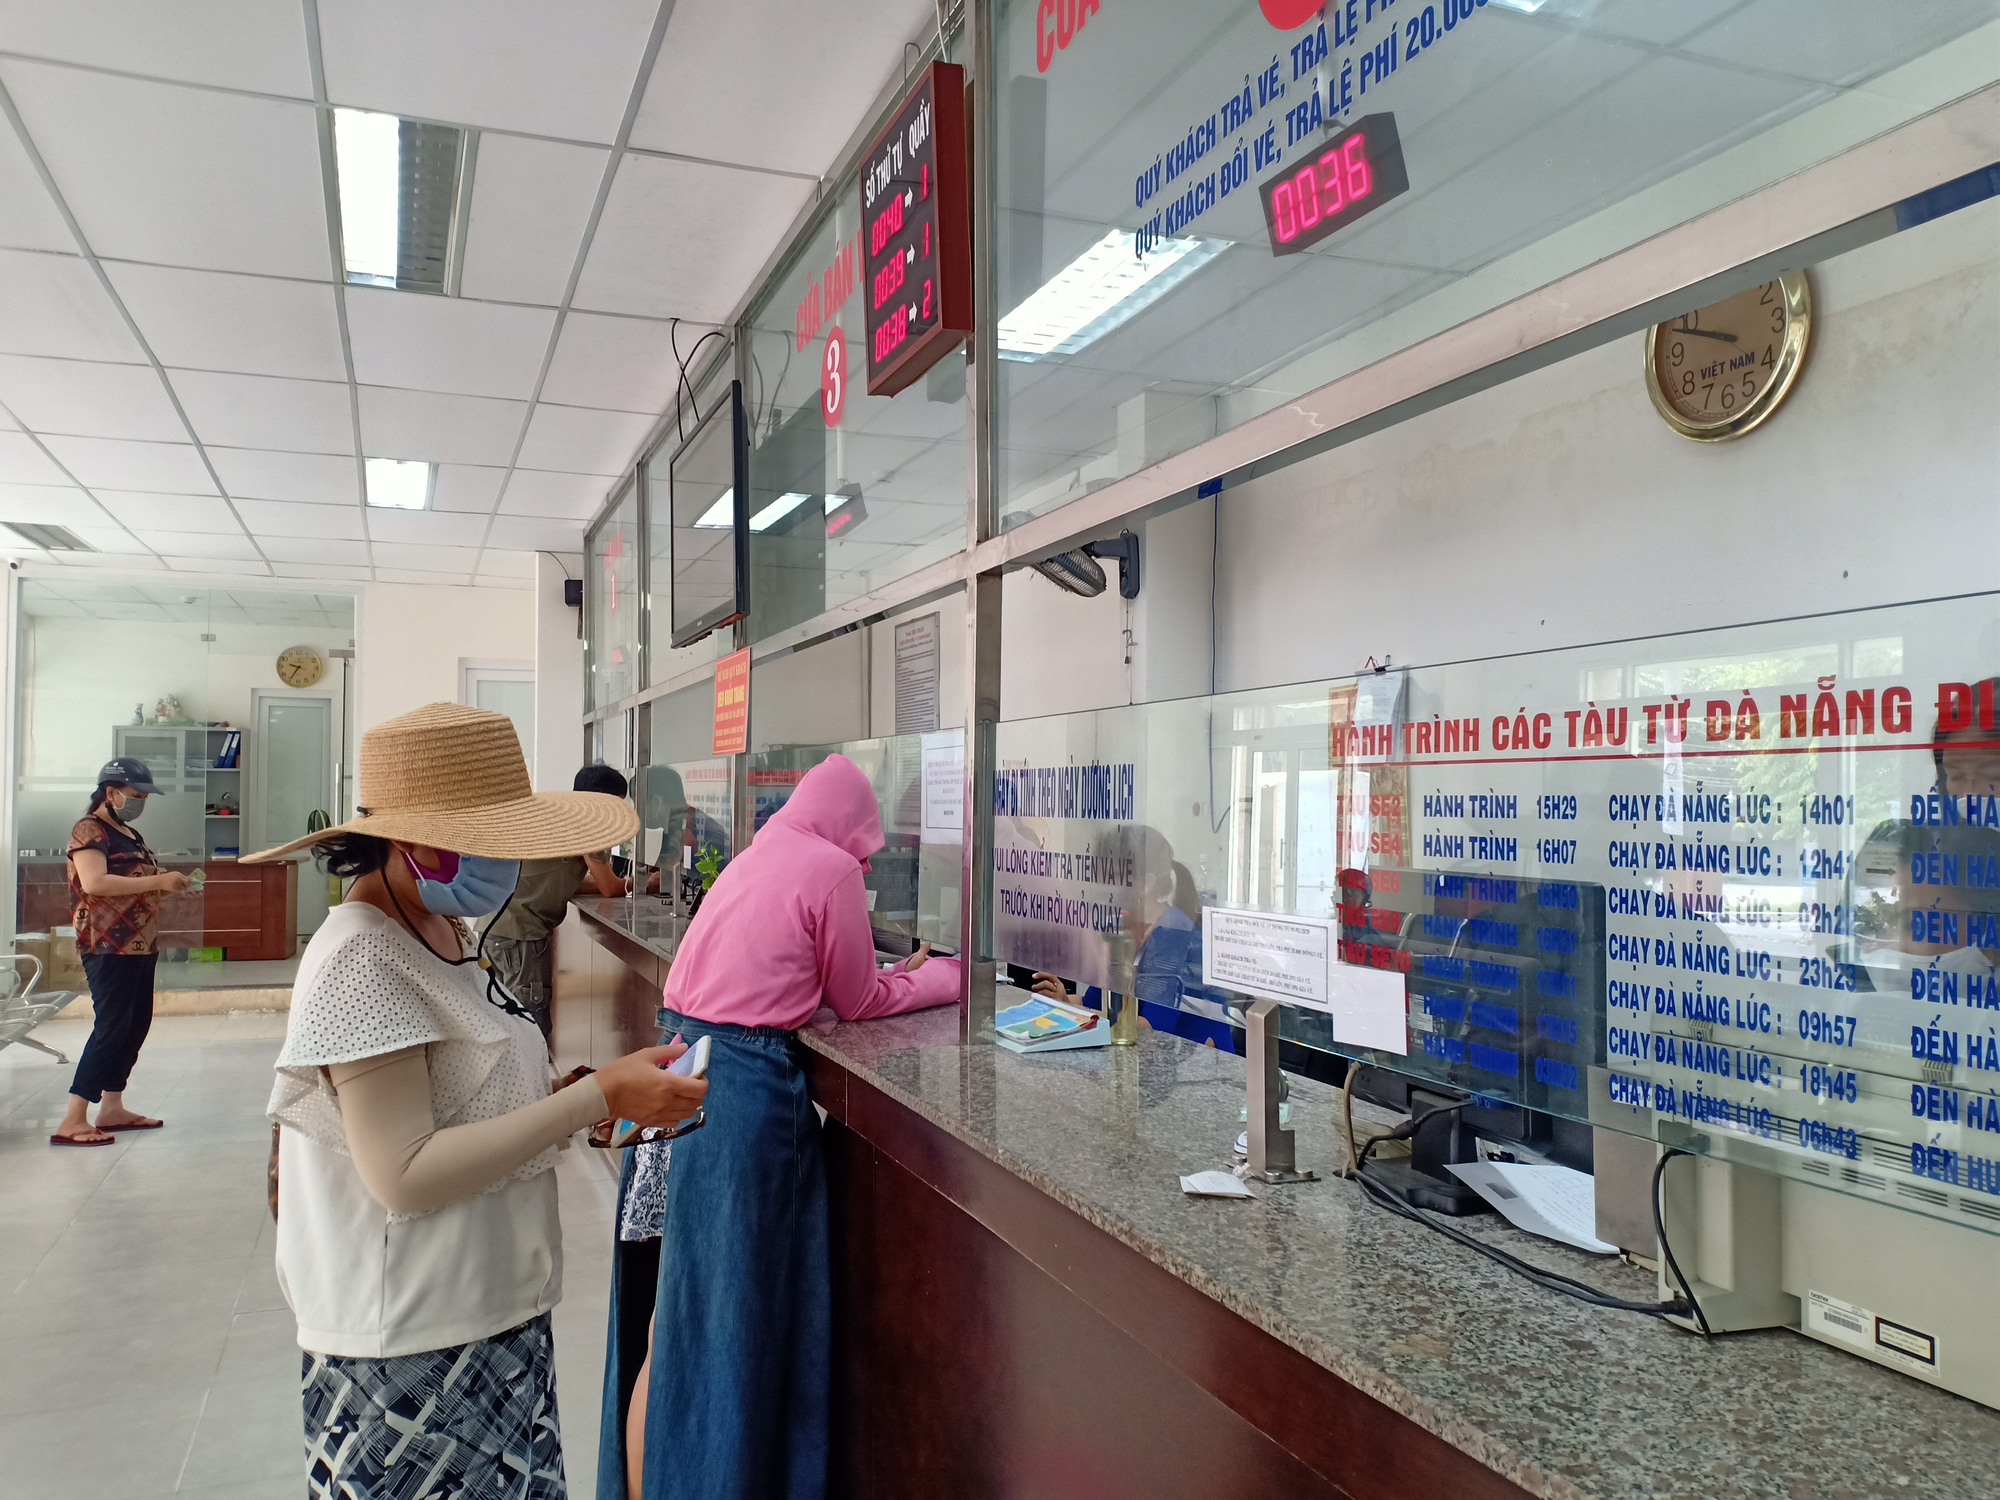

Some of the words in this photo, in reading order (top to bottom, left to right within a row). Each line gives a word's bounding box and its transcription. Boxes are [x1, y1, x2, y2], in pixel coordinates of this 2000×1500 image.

[1135, 208, 1162, 260] QUÝ
[1165, 173, 1216, 239] KHÁCH
[1220, 137, 1248, 199] ĐỔI
[1253, 119, 1282, 173] VÉ,
[1285, 77, 1323, 148] TRẢ
[1328, 57, 1353, 117] LỆ
[1360, 21, 1398, 96] PHÍ
[1136, 154, 1162, 209] QUÝ
[1165, 114, 1216, 184] KHÁCH
[1220, 74, 1253, 139] TRẢ
[1257, 54, 1286, 109] VÉ,
[1290, 8, 1329, 82] TRẢ
[865, 160, 876, 209] SỐ
[892, 130, 904, 177] TỰ
[908, 98, 931, 159] QUẦY
[1271, 132, 1372, 244] 0036
[871, 192, 904, 259] 0040
[823, 240, 854, 323] BÁN
[873, 247, 906, 311] 0039
[1758, 280, 1774, 306] 2
[874, 302, 908, 364] 0038
[922, 278, 932, 320] 2
[1771, 307, 1785, 334] 3
[826, 339, 842, 414] 3
[1671, 342, 1685, 367] 9
[1682, 370, 1696, 396] 8
[1700, 361, 1726, 381] VIỆT
[1729, 351, 1756, 372] NAM
[1741, 370, 1756, 398] 5
[1760, 344, 1776, 371] 4
[1701, 383, 1715, 410] 7
[1720, 384, 1735, 410] 6
[1332, 716, 1393, 757] HÀNH
[1401, 713, 1480, 755] TRÌNH
[1491, 706, 1552, 751] CÁC
[1563, 701, 1629, 749] TÀU
[1642, 694, 1691, 744] TỪ
[1704, 689, 1761, 742] ĐÀ
[1779, 674, 1913, 738] NẴNG
[1933, 679, 1995, 733] ĐI
[1019, 758, 1036, 818] TÍNH
[1037, 767, 1056, 819] THEO
[1057, 755, 1080, 819] NGÀY
[1081, 759, 1111, 820] DƯƠNG
[1113, 763, 1135, 833] LỊCH
[1370, 795, 1401, 817] SE2
[1423, 789, 1465, 818] HÀNH
[1469, 788, 1518, 819] TRÌNH
[1536, 795, 1578, 821] 15H29
[1608, 794, 1651, 829] CHẠY
[1655, 787, 1677, 823] ĐÀ
[1682, 780, 1730, 824] NẴNG
[1735, 786, 1771, 824] LÚC
[1799, 794, 1857, 825] 14h01
[1911, 780, 1958, 827] ĐẾN
[1966, 784, 2000, 828] HÀ
[1005, 841, 1029, 874] LÒNG
[1030, 837, 1052, 878] KIỂM
[1054, 852, 1073, 880] TRA
[1075, 843, 1098, 884] TIỀN
[1101, 849, 1116, 886] VÀ
[1118, 851, 1133, 888] VÉ
[1370, 831, 1402, 855] SE4
[1423, 828, 1465, 859] HÀNH
[1469, 829, 1518, 862] TRÌNH
[1536, 838, 1578, 865] 16H07
[1608, 840, 1651, 876] CHẠY
[1655, 834, 1677, 870] ĐÀ
[1682, 830, 1730, 873] NẴNG
[1735, 838, 1771, 876] LÚC
[1799, 849, 1857, 880] 12h41
[1911, 838, 1958, 886] ĐẾN
[1966, 844, 2000, 889] HÀ
[1000, 884, 1028, 918] TRƯỚC
[1030, 893, 1046, 921] KHI
[1047, 889, 1063, 924] RỜI
[1065, 889, 1089, 929] KHỎI
[1091, 892, 1122, 935] QUẦY
[1370, 868, 1401, 893] SE6
[1423, 868, 1465, 899] HÀNH
[1469, 871, 1518, 904] TRÌNH
[1655, 883, 1677, 919] ĐÀ
[1682, 879, 1730, 924] NẴNG
[1911, 897, 1958, 945] ĐẾN
[1966, 905, 2000, 950] HÀ
[1608, 933, 1651, 971] CHẠY
[1655, 932, 1677, 967] ĐÀ
[1682, 929, 1730, 976] NẴNG
[1799, 956, 1857, 992] 23h23
[1911, 956, 1958, 1005] ĐẾN
[1966, 966, 2000, 1011] HÀ
[1336, 934, 1366, 965] TÀU
[1370, 944, 1412, 973] SE10
[1608, 980, 1651, 1019] CHẠY
[1655, 980, 1677, 1017] ĐÀ
[1682, 979, 1730, 1027] NẴNG
[1735, 993, 1771, 1034] LÚC
[1799, 1009, 1857, 1048] 09h57
[1911, 1015, 1958, 1065] ĐẾN
[1966, 1027, 2000, 1072] HÀ
[1608, 1026, 1651, 1066] CHẠY
[1655, 1029, 1677, 1066] ĐÀ
[1735, 1045, 1771, 1086] LÚC
[1799, 1063, 1857, 1104] 18h45
[1966, 1088, 2000, 1134] HÀ
[1608, 1073, 1651, 1114] CHẠY
[1655, 1078, 1677, 1116] ĐÀ
[1682, 1079, 1730, 1123] NẴNG
[1735, 1097, 1771, 1138] LÚC
[1799, 1117, 1857, 1160] 06h43
[1911, 1132, 1958, 1185] ĐẾN
[1810, 1291, 1830, 1303] brother
